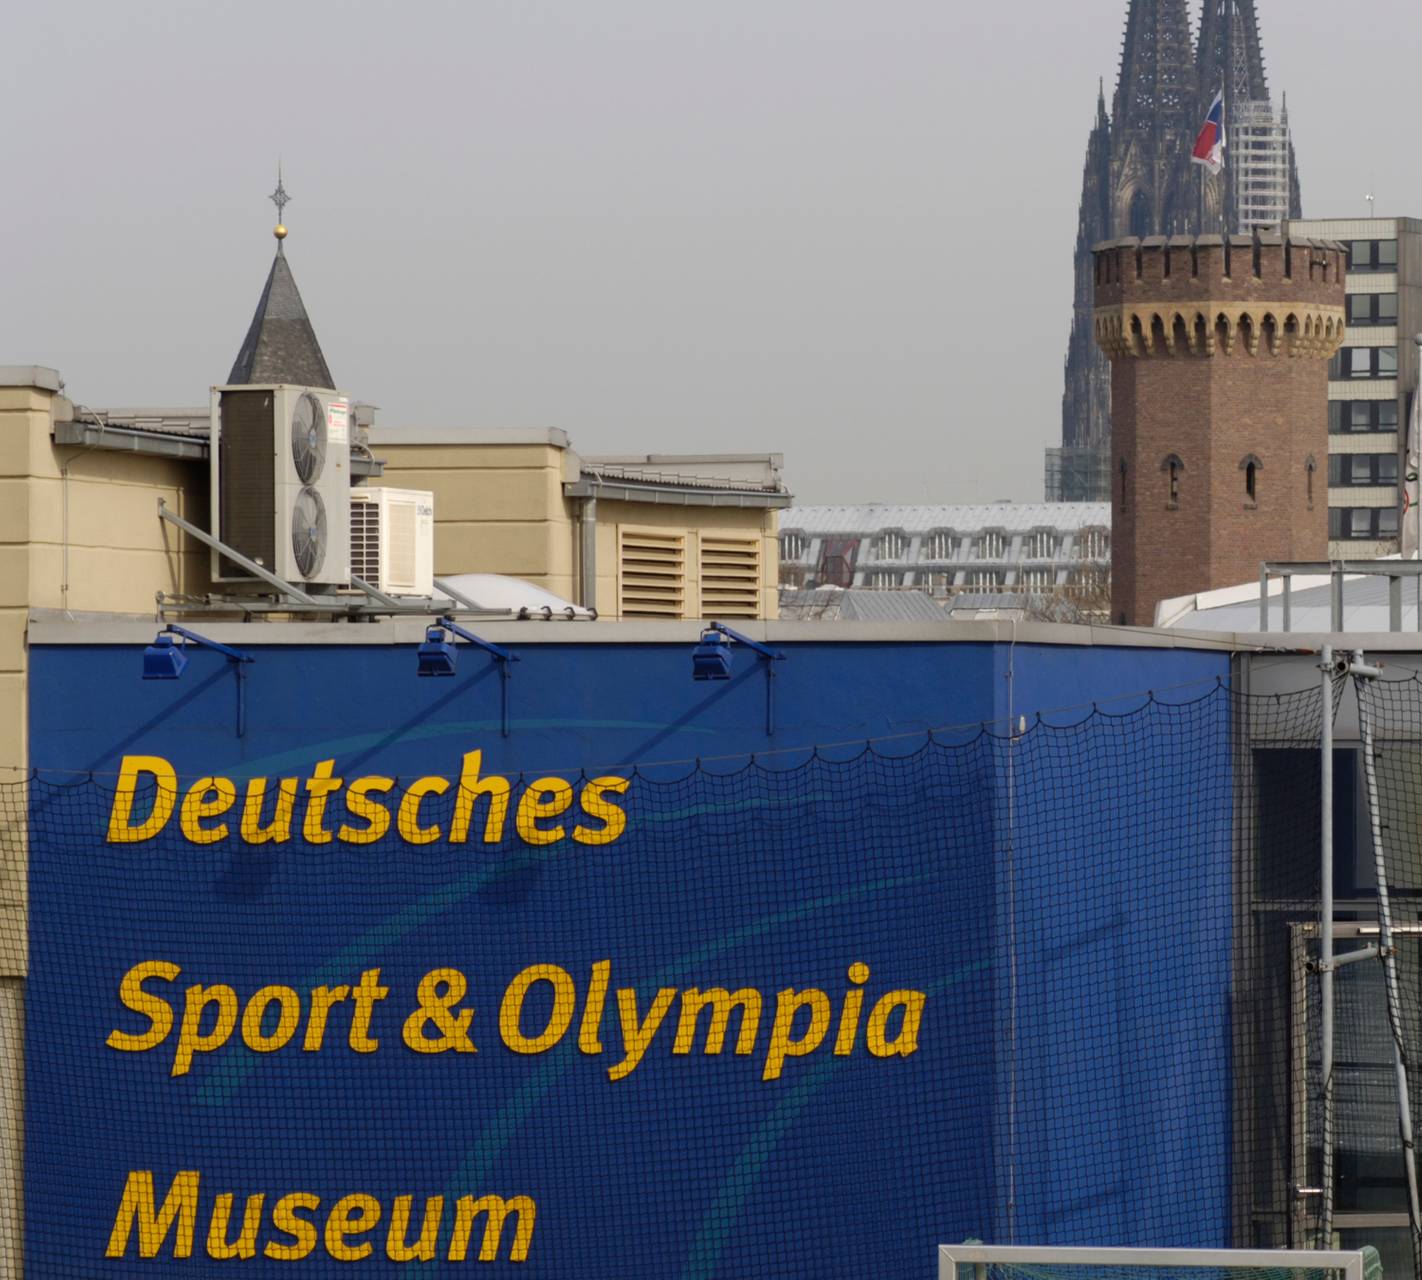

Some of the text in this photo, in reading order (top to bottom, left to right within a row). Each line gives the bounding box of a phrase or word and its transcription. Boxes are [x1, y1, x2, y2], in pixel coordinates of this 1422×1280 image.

[107, 750, 629, 845] Deutsches
[106, 959, 926, 1081] Sport & Olympia
[105, 1170, 536, 1262] Museum
